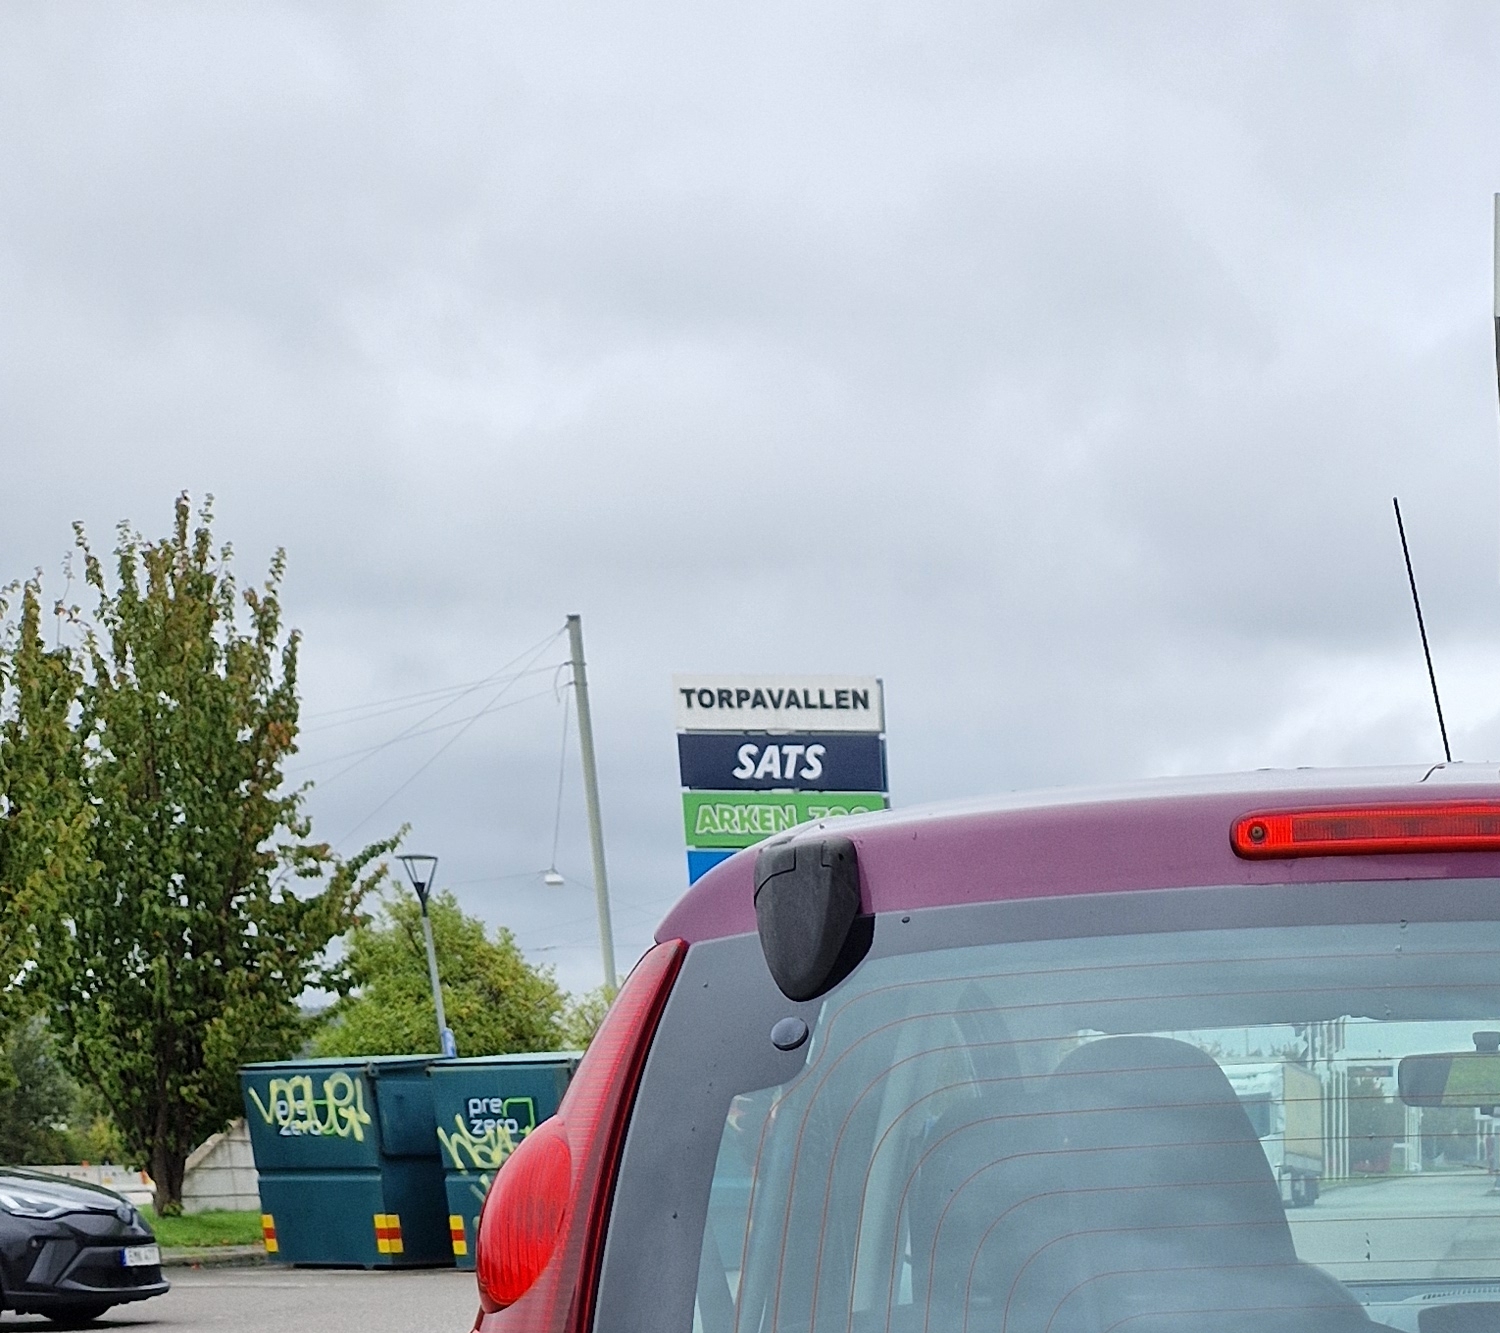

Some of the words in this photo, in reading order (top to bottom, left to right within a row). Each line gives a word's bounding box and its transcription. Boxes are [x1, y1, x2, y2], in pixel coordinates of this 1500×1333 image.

[680, 687, 869, 710] TORPAVALLEN
[732, 743, 826, 780] SATS
[695, 803, 798, 834] ARKEN
[468, 1097, 503, 1118] pre
